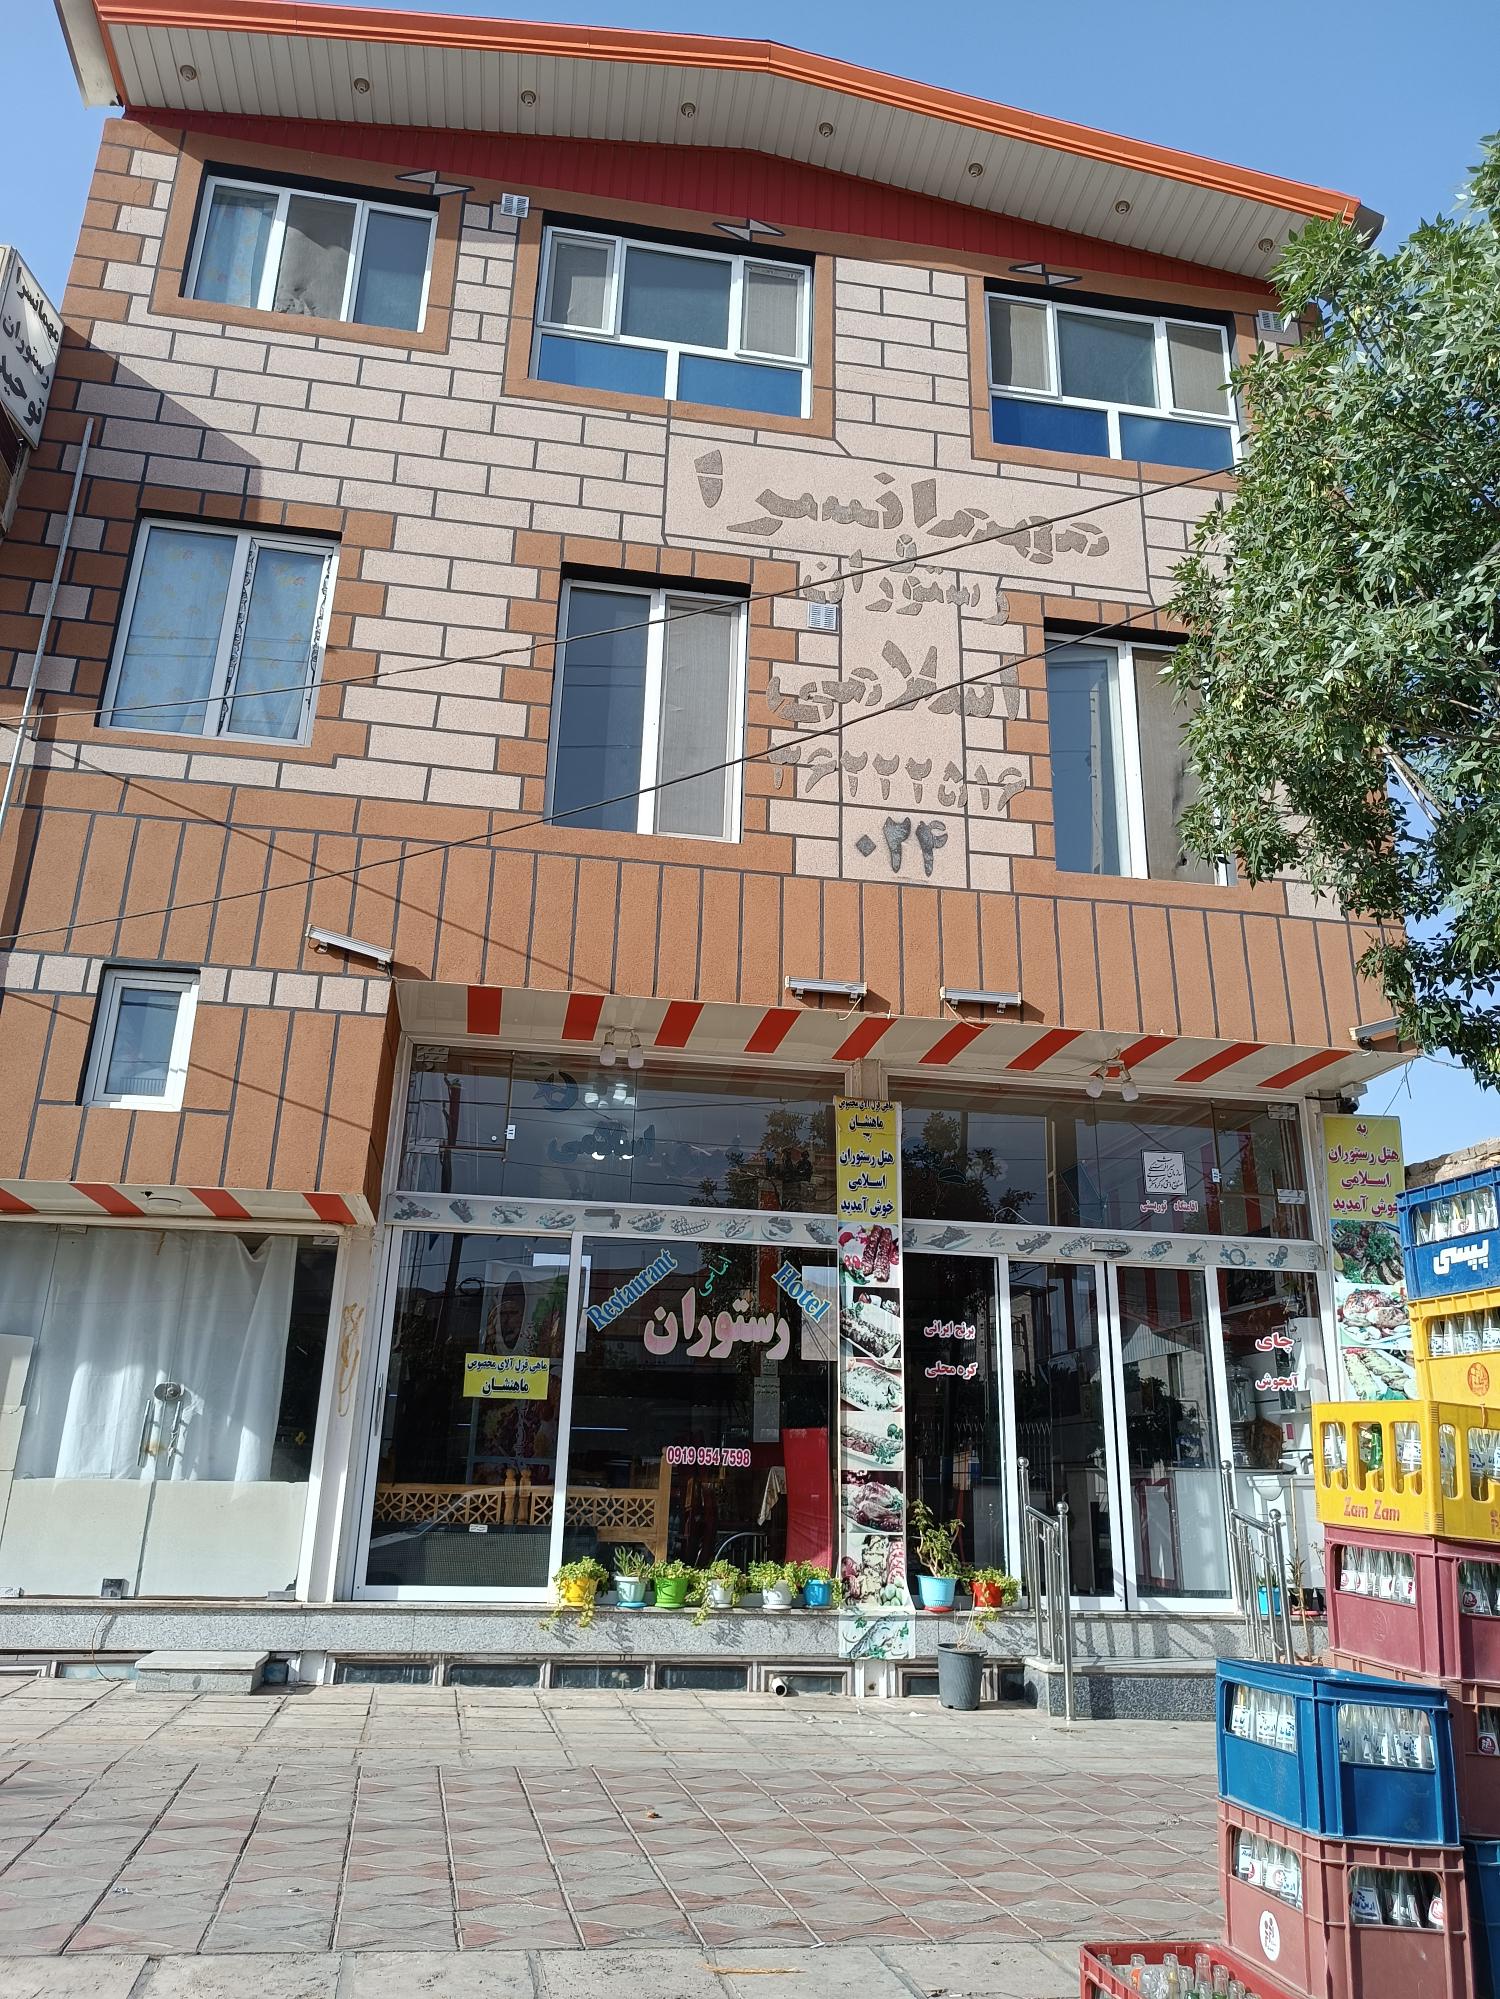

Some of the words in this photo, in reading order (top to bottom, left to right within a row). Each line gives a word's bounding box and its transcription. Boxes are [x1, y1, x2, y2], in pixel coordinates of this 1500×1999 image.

[16, 267, 60, 343] مهمانسرا
[2, 316, 50, 390] رستوران
[694, 449, 1110, 565] مهمانسرا
[801, 548, 1011, 627] رستوران
[766, 639, 1021, 724] اسلامی
[848, 1113, 885, 1132] ماهنشان
[1356, 1123, 1367, 1137] به
[839, 1148, 876, 1168] رستوران
[877, 1150, 894, 1168] هتل
[1328, 1144, 1375, 1165] رستوران
[1377, 1146, 1400, 1165] هتل
[848, 1173, 887, 1191] اسلامی
[1341, 1170, 1391, 1189] اسلامی
[841, 1196, 869, 1216] آمدید
[870, 1199, 894, 1218] خوش
[1140, 1199, 1168, 1214] توریستی
[1173, 1199, 1199, 1213] اقامتگاه
[1332, 1195, 1368, 1214] آمدید
[1432, 1239, 1490, 1276] پپسی
[585, 1248, 679, 1332] Restaurant
[770, 1260, 833, 1324] Hotel
[643, 1286, 791, 1361] رستوران
[924, 1319, 954, 1338] ایرانی
[953, 1321, 976, 1340] برنج
[1255, 1332, 1295, 1353] چای
[467, 1358, 496, 1371] مخصوص
[515, 1358, 528, 1373] قزل
[529, 1359, 548, 1373] ماهی
[925, 1360, 956, 1378] محلی
[957, 1362, 978, 1380] کره
[482, 1377, 530, 1395] ماهنشان
[666, 1446, 696, 1465] 0919
[697, 1447, 720, 1466] 954
[721, 1448, 751, 1467] 7598
[1343, 1496, 1369, 1519] Zam
[1374, 1499, 1401, 1522] Zam
